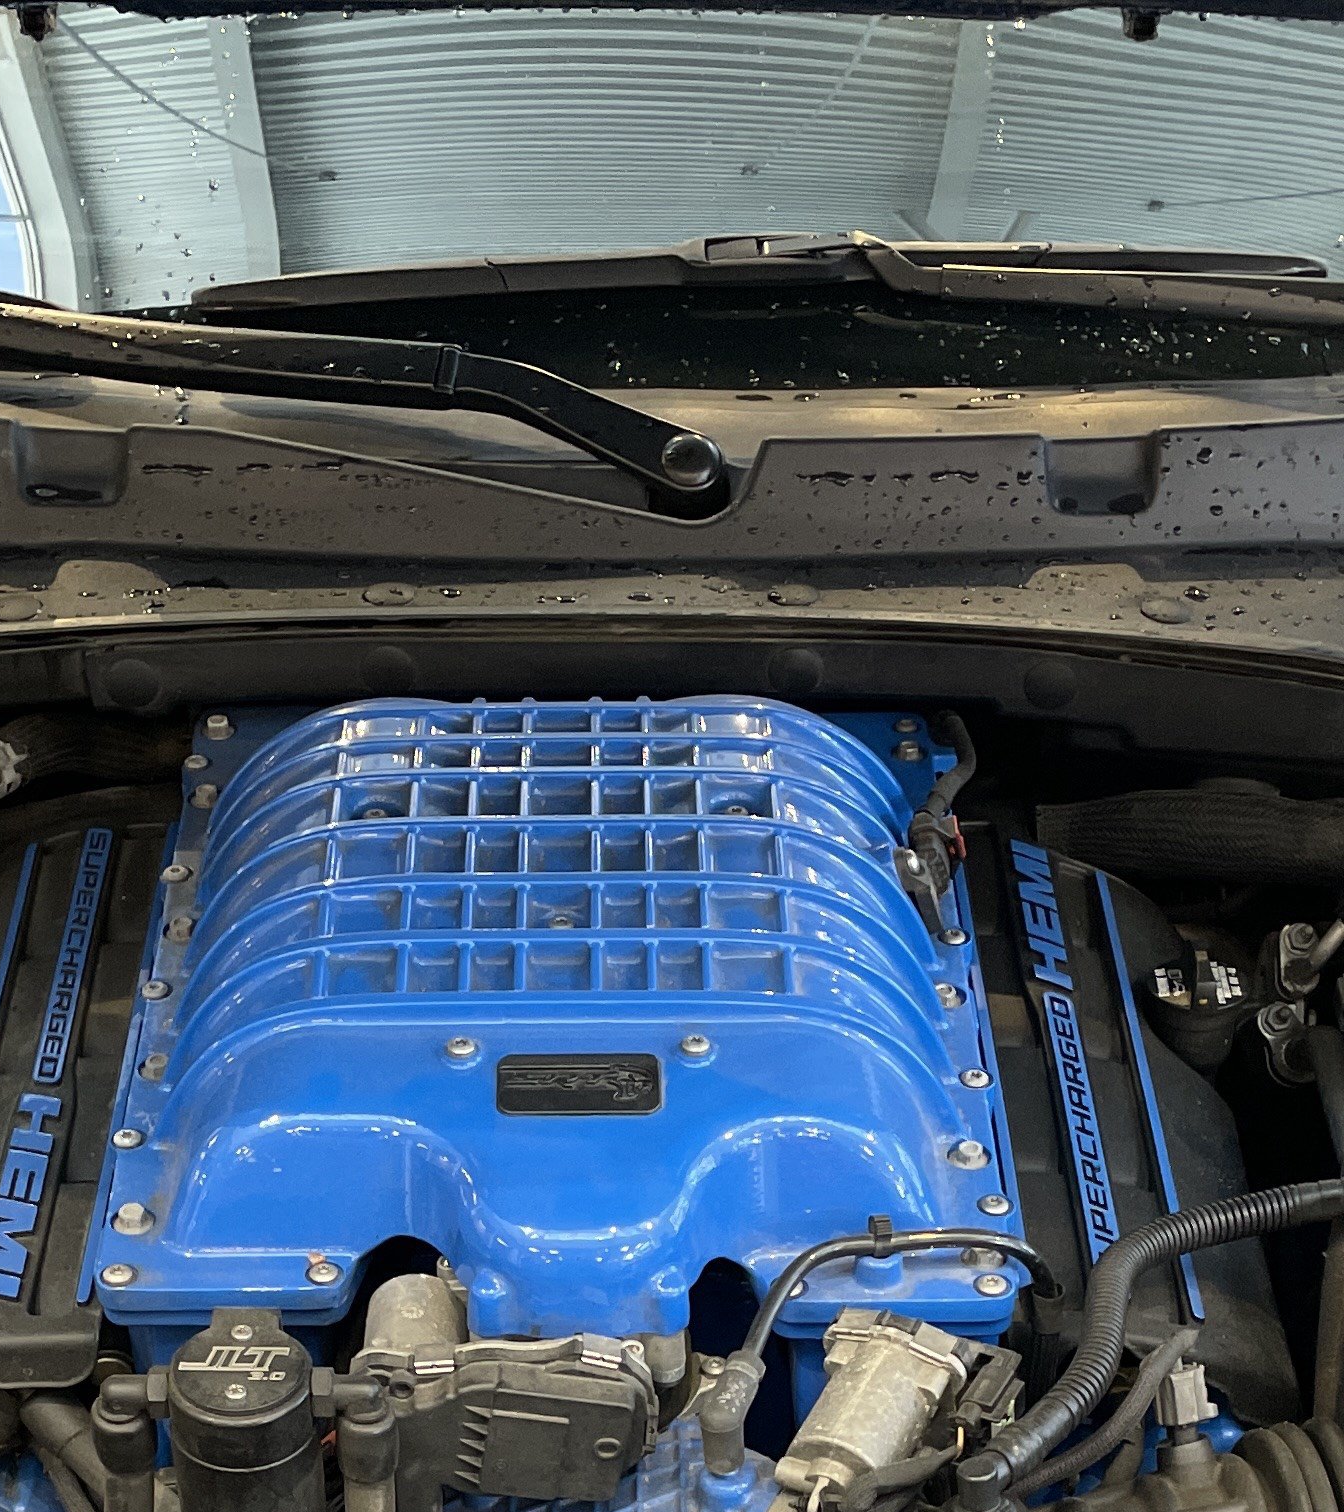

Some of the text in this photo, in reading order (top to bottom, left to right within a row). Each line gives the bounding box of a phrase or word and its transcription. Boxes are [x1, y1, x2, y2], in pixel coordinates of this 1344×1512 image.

[39, 831, 109, 1079] SUPERCHARGED
[1010, 839, 1073, 991] HEMI
[1049, 996, 1115, 1257] PERCHARGED
[178, 1345, 291, 1372] JLT
